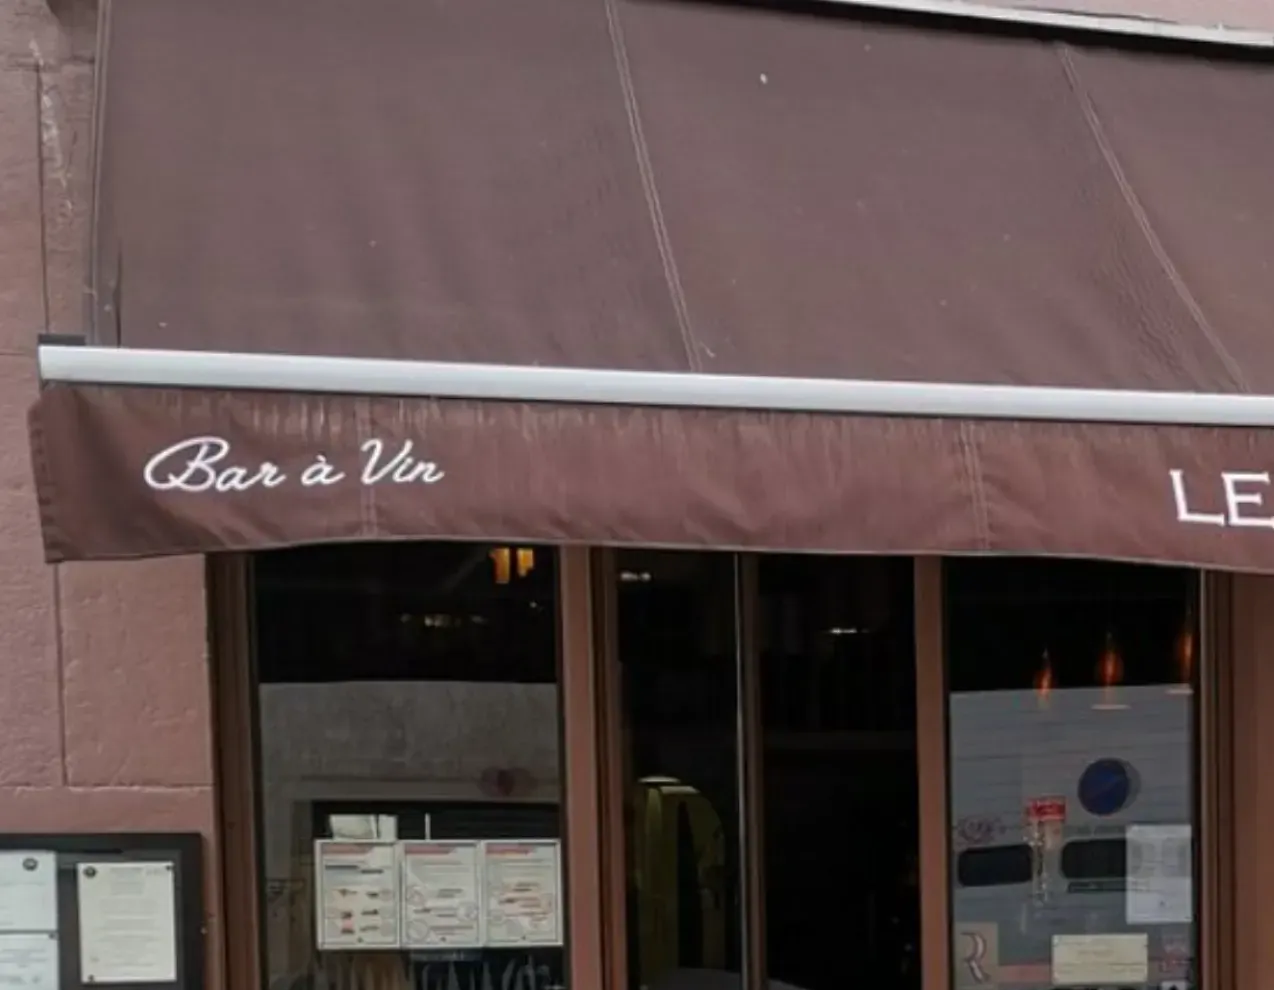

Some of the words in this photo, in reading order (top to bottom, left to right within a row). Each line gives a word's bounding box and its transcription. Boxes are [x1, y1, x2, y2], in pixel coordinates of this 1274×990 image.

[143, 436, 287, 492] Bar
[301, 454, 345, 486] à
[361, 438, 445, 485] Vin
